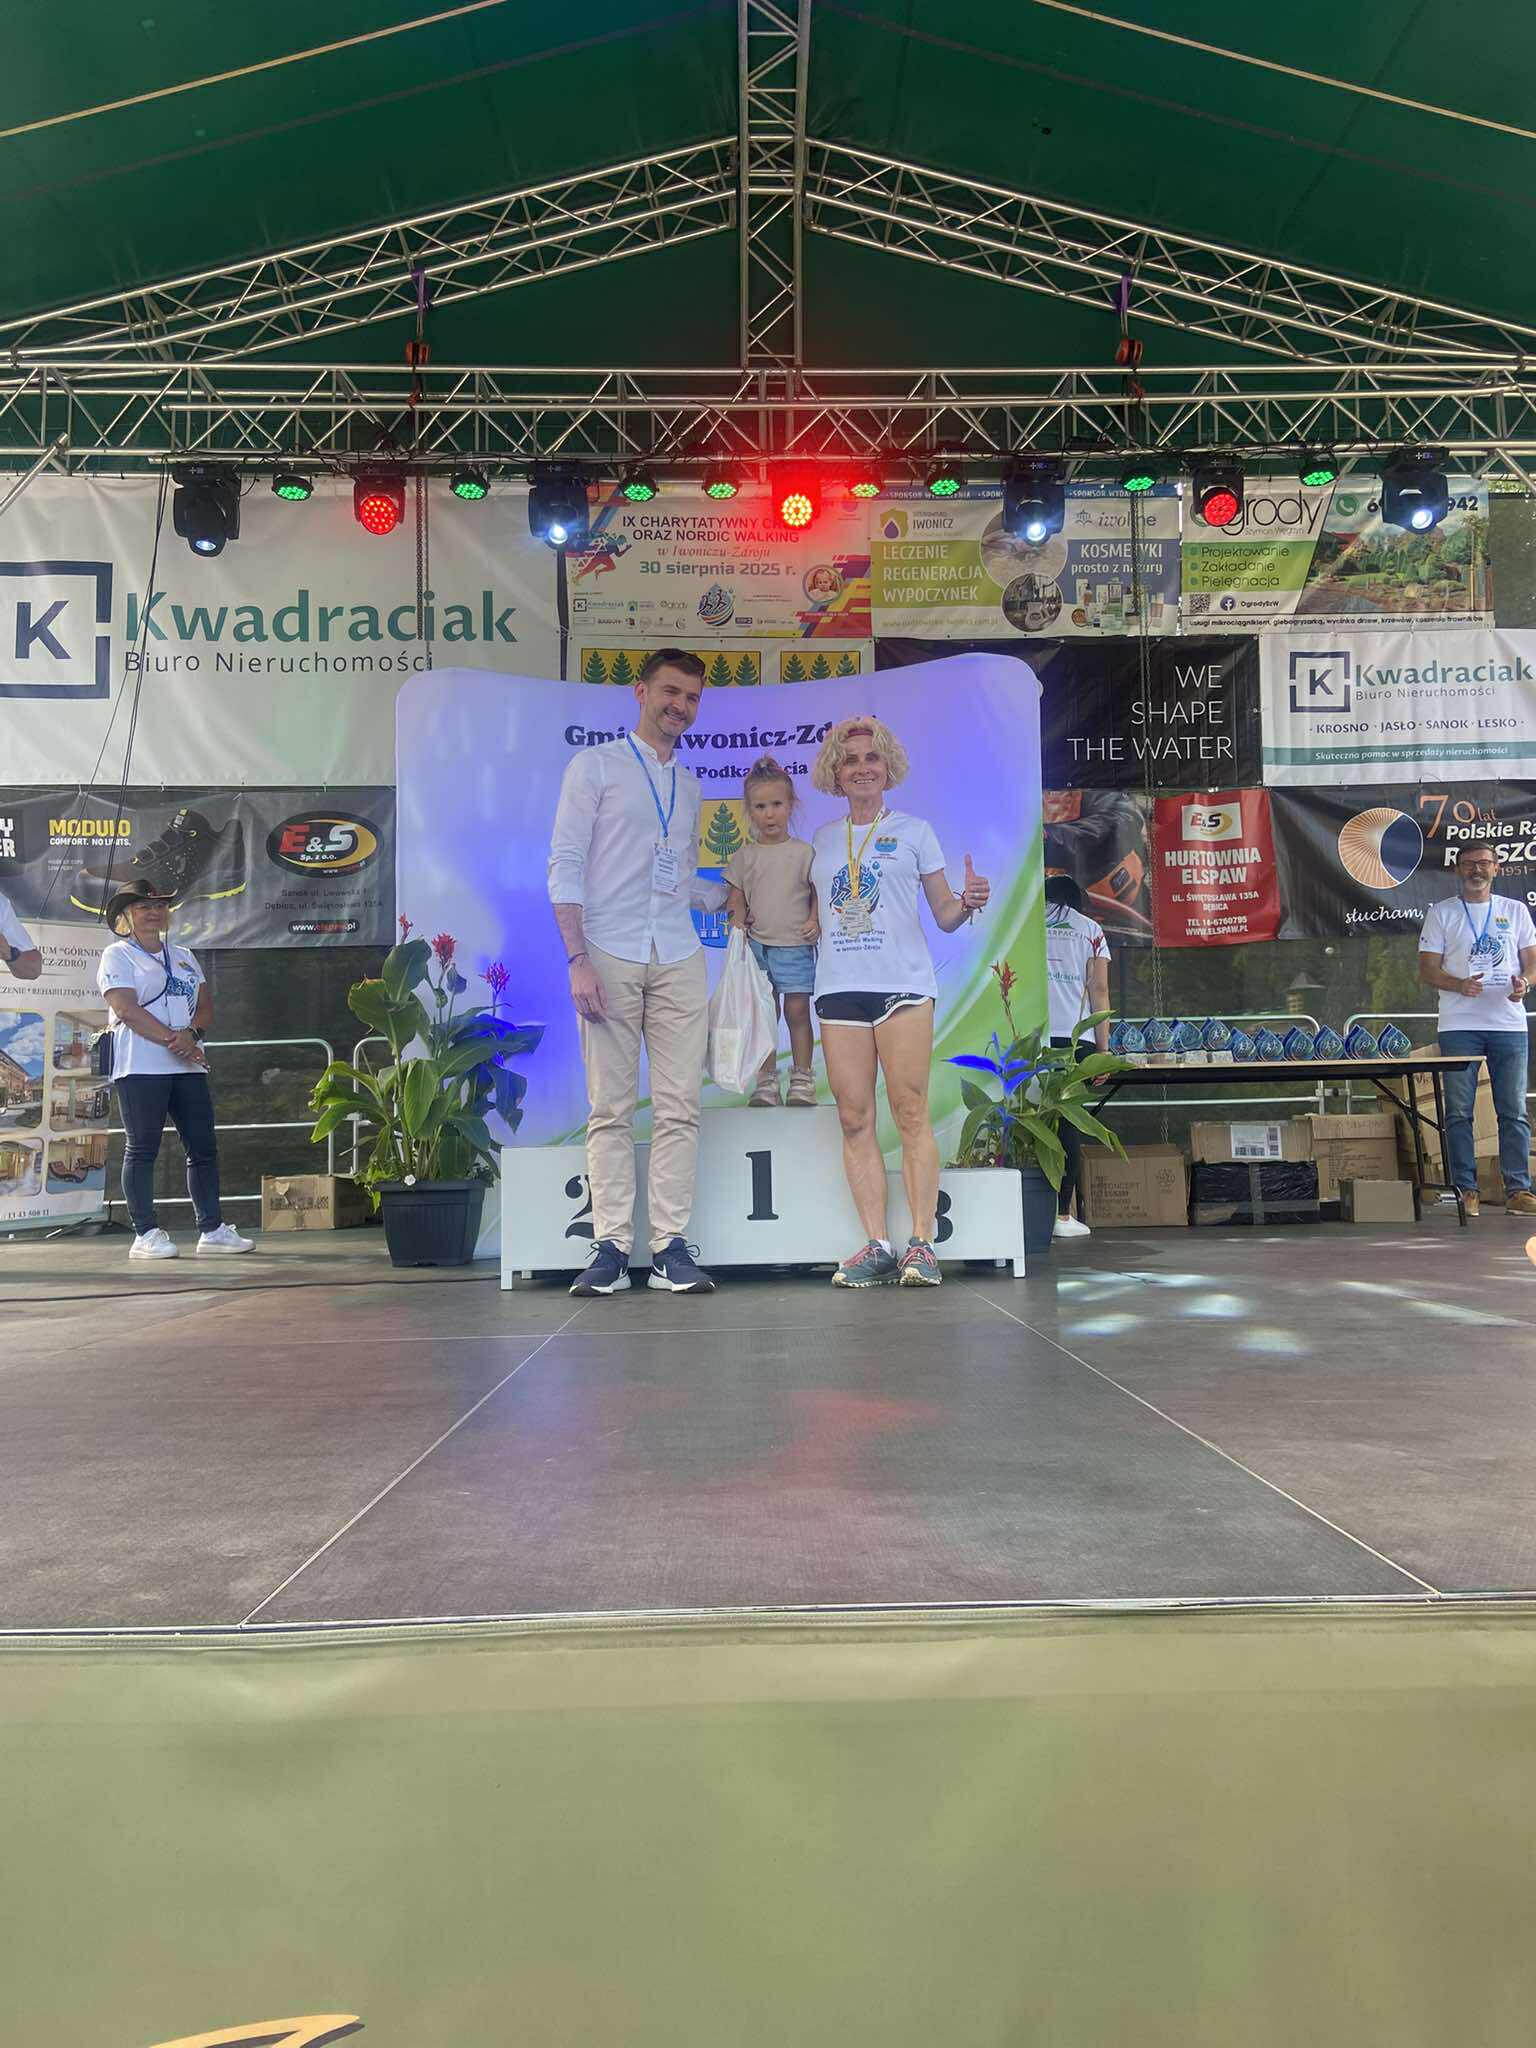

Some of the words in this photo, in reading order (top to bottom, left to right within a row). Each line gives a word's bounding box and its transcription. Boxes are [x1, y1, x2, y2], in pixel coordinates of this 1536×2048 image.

[1098, 511, 1157, 528] iwolne
[1190, 489, 1323, 535] grody
[623, 516, 636, 527] IX
[640, 516, 759, 529] CHARYTATYWNY
[913, 518, 953, 529] IWONICZ
[633, 530, 672, 541] ORAZ
[676, 530, 730, 542] NORDIC
[735, 532, 799, 543] WALKING
[883, 544, 949, 560] LECZENIE
[1201, 546, 1290, 558] Projektowanie
[640, 561, 661, 574] 30
[666, 562, 735, 576] sierpnia
[740, 563, 780, 575] 2025
[786, 564, 796, 575] r.
[883, 565, 984, 582] REGENERACJA
[1072, 562, 1109, 575] prosto
[1112, 564, 1120, 573] z
[1201, 560, 1275, 573] Zakładanie
[1202, 574, 1280, 588] Pielęgnacja
[883, 586, 978, 603] WYPOCZYNEK
[125, 590, 519, 643] Kwadraciak
[14, 600, 72, 660] K
[125, 651, 200, 673] Biuro
[216, 650, 433, 673] Nieruchomości
[1176, 665, 1223, 688] WE
[1355, 657, 1533, 687] Kwadraciak
[1309, 669, 1334, 695] K
[1355, 689, 1392, 701] Biuro
[1397, 685, 1496, 699] Nieruchomości
[1131, 701, 1224, 724] SHAPE
[1316, 722, 1369, 734] KROSNO
[1380, 720, 1416, 732] JASŁO
[1426, 719, 1469, 730] SANOK
[1478, 717, 1517, 729] LESKO
[1067, 738, 1124, 760] THE
[1132, 737, 1233, 760] WATER
[1315, 751, 1360, 761] Skuteczna
[1361, 751, 1391, 760] pomoc
[1477, 807, 1497, 821] lat
[280, 823, 357, 853] E&S
[1446, 822, 1514, 840] Polskie
[50, 838, 88, 846] COMFORT.
[92, 838, 104, 846] NO
[1165, 848, 1262, 867] HURTOWNIA
[1182, 867, 1247, 885] ELSPAW
[1172, 894, 1184, 902] UL.
[1239, 890, 1259, 900] 135A
[1203, 903, 1229, 912] DĘBICA
[1345, 903, 1424, 925] słucham,
[745, 1150, 779, 1221] 1
